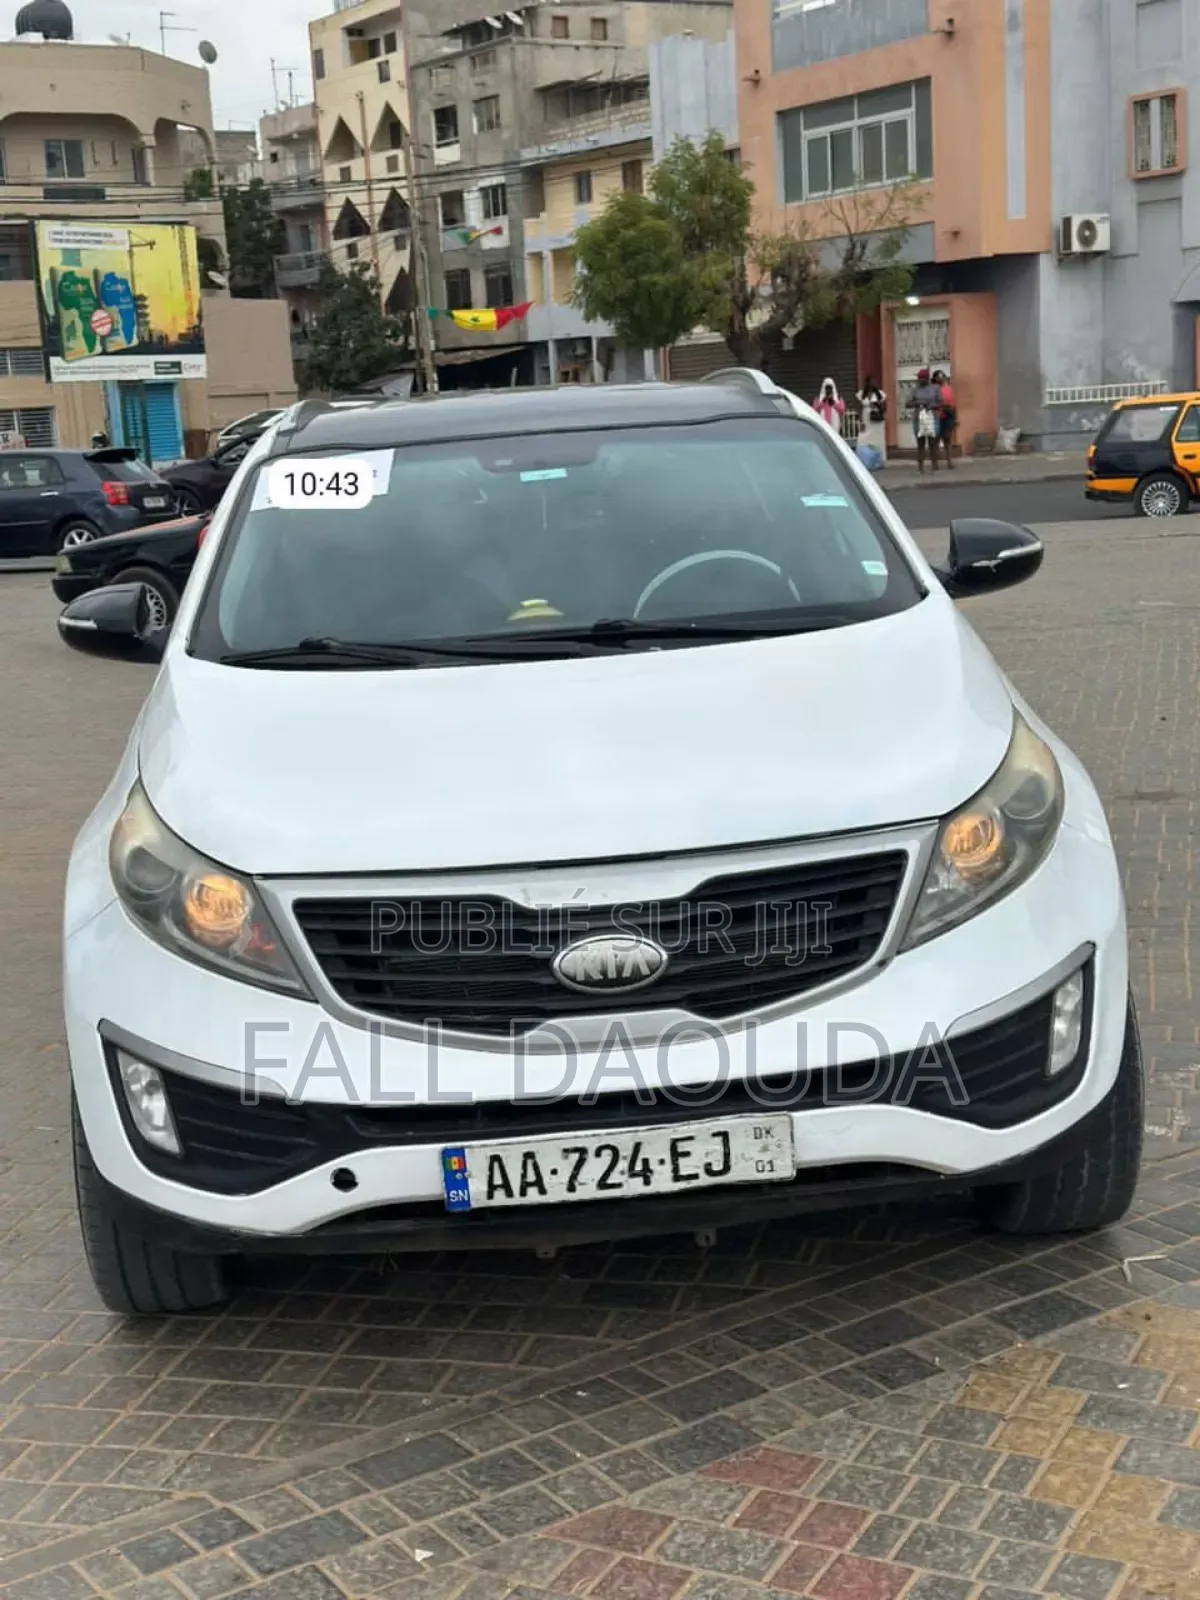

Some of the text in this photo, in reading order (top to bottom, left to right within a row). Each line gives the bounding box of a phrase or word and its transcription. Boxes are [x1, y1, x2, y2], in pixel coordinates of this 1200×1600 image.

[575, 948, 651, 981] KIA
[753, 1126, 776, 1140] DK
[448, 1189, 470, 1204] SN
